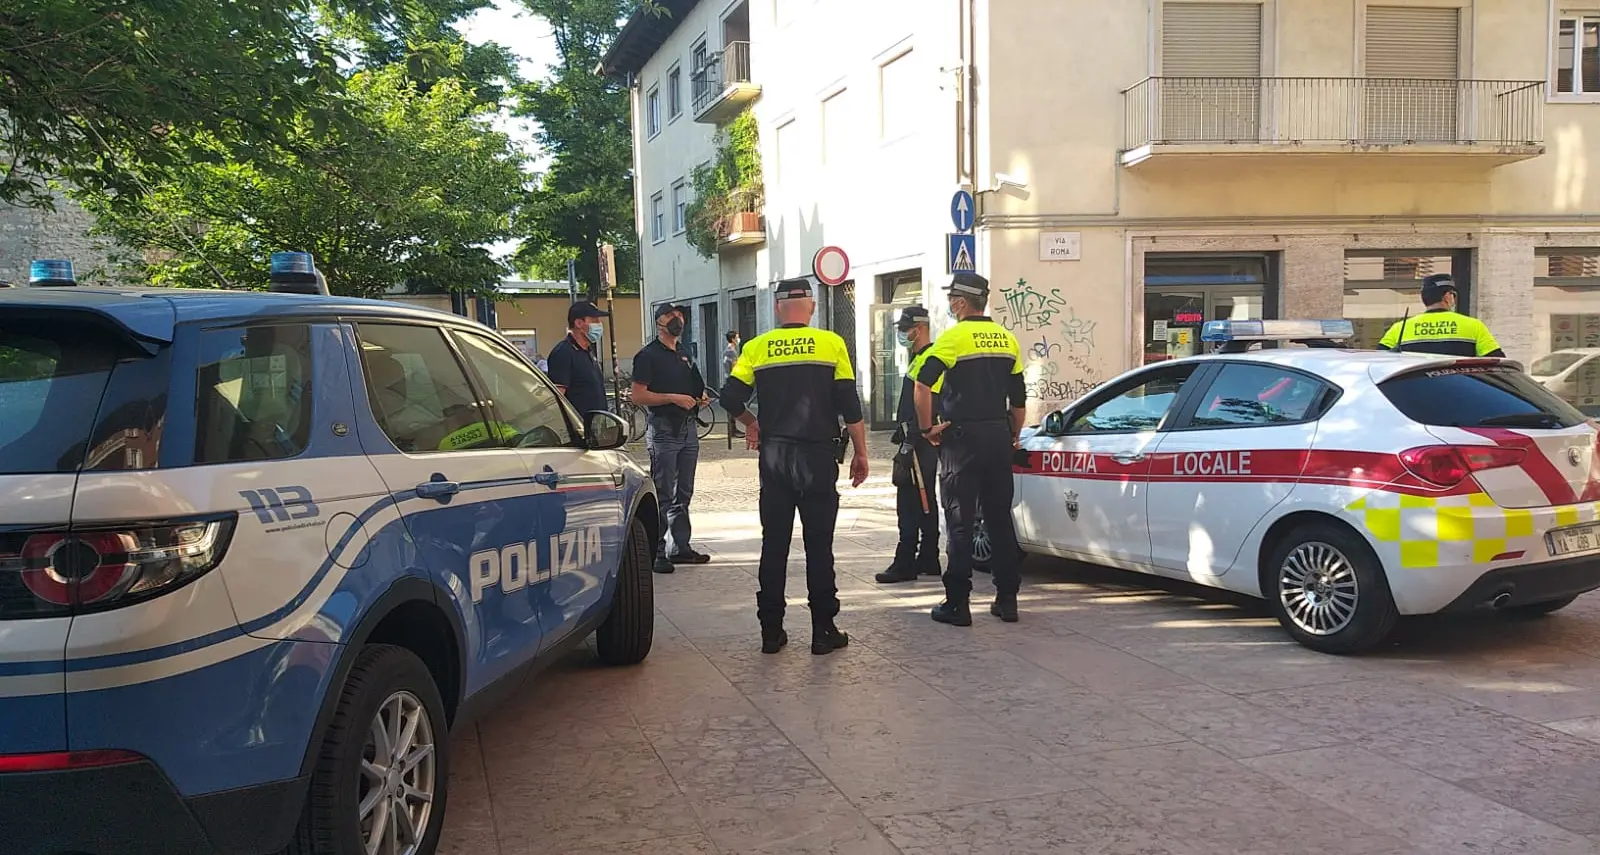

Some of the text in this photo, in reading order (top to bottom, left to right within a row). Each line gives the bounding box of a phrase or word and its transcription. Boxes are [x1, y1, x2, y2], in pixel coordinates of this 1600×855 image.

[1414, 320, 1458, 329] POLIZIA
[972, 332, 1008, 340] POLIZIA
[1414, 327, 1458, 336] LOCALE
[767, 337, 816, 349] POLIZIA
[975, 340, 1010, 349] LOCALE
[767, 345, 816, 358] LOCALE
[1041, 451, 1252, 476] POLIZIA LOCALE
[237, 486, 320, 525] 113
[469, 525, 602, 605] POLIZIA
